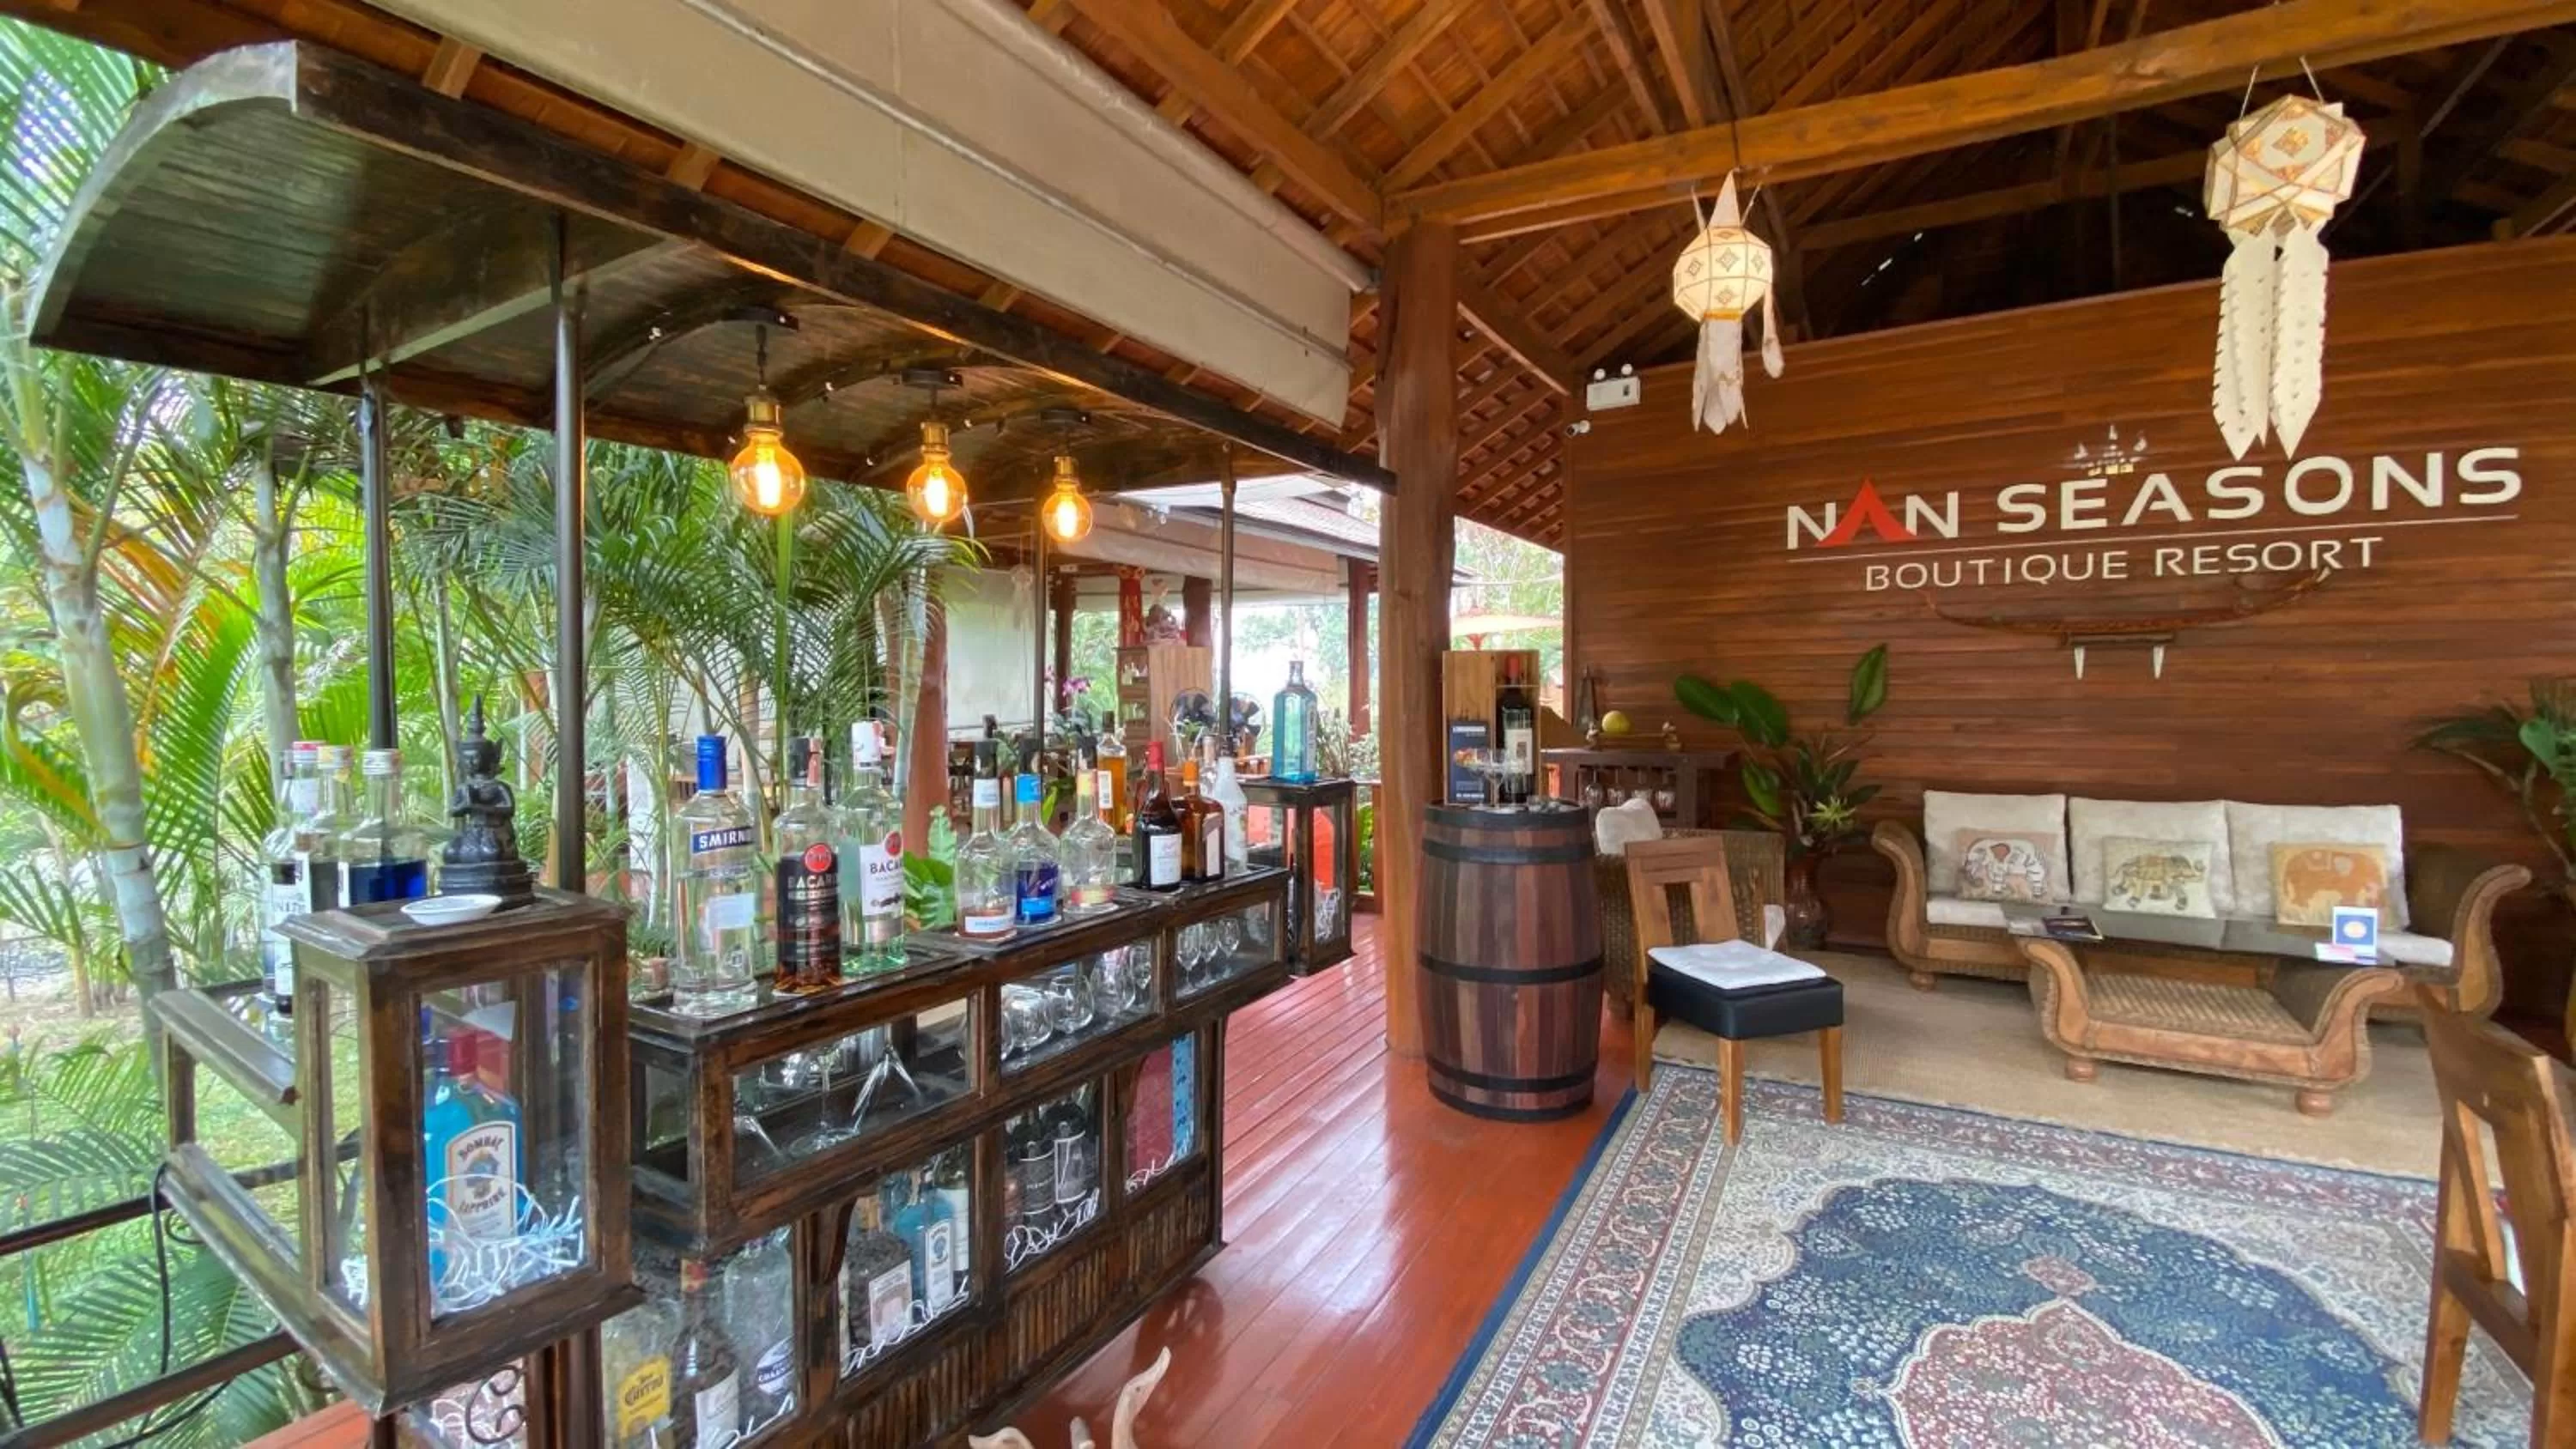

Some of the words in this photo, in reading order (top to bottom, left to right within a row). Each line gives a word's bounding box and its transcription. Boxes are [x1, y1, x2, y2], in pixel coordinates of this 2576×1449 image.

[1786, 476, 1959, 550] NAN
[1996, 446, 2523, 533] SEASONS
[1865, 549, 2129, 591] BOUTIQUE
[2154, 536, 2385, 577] RESORT
